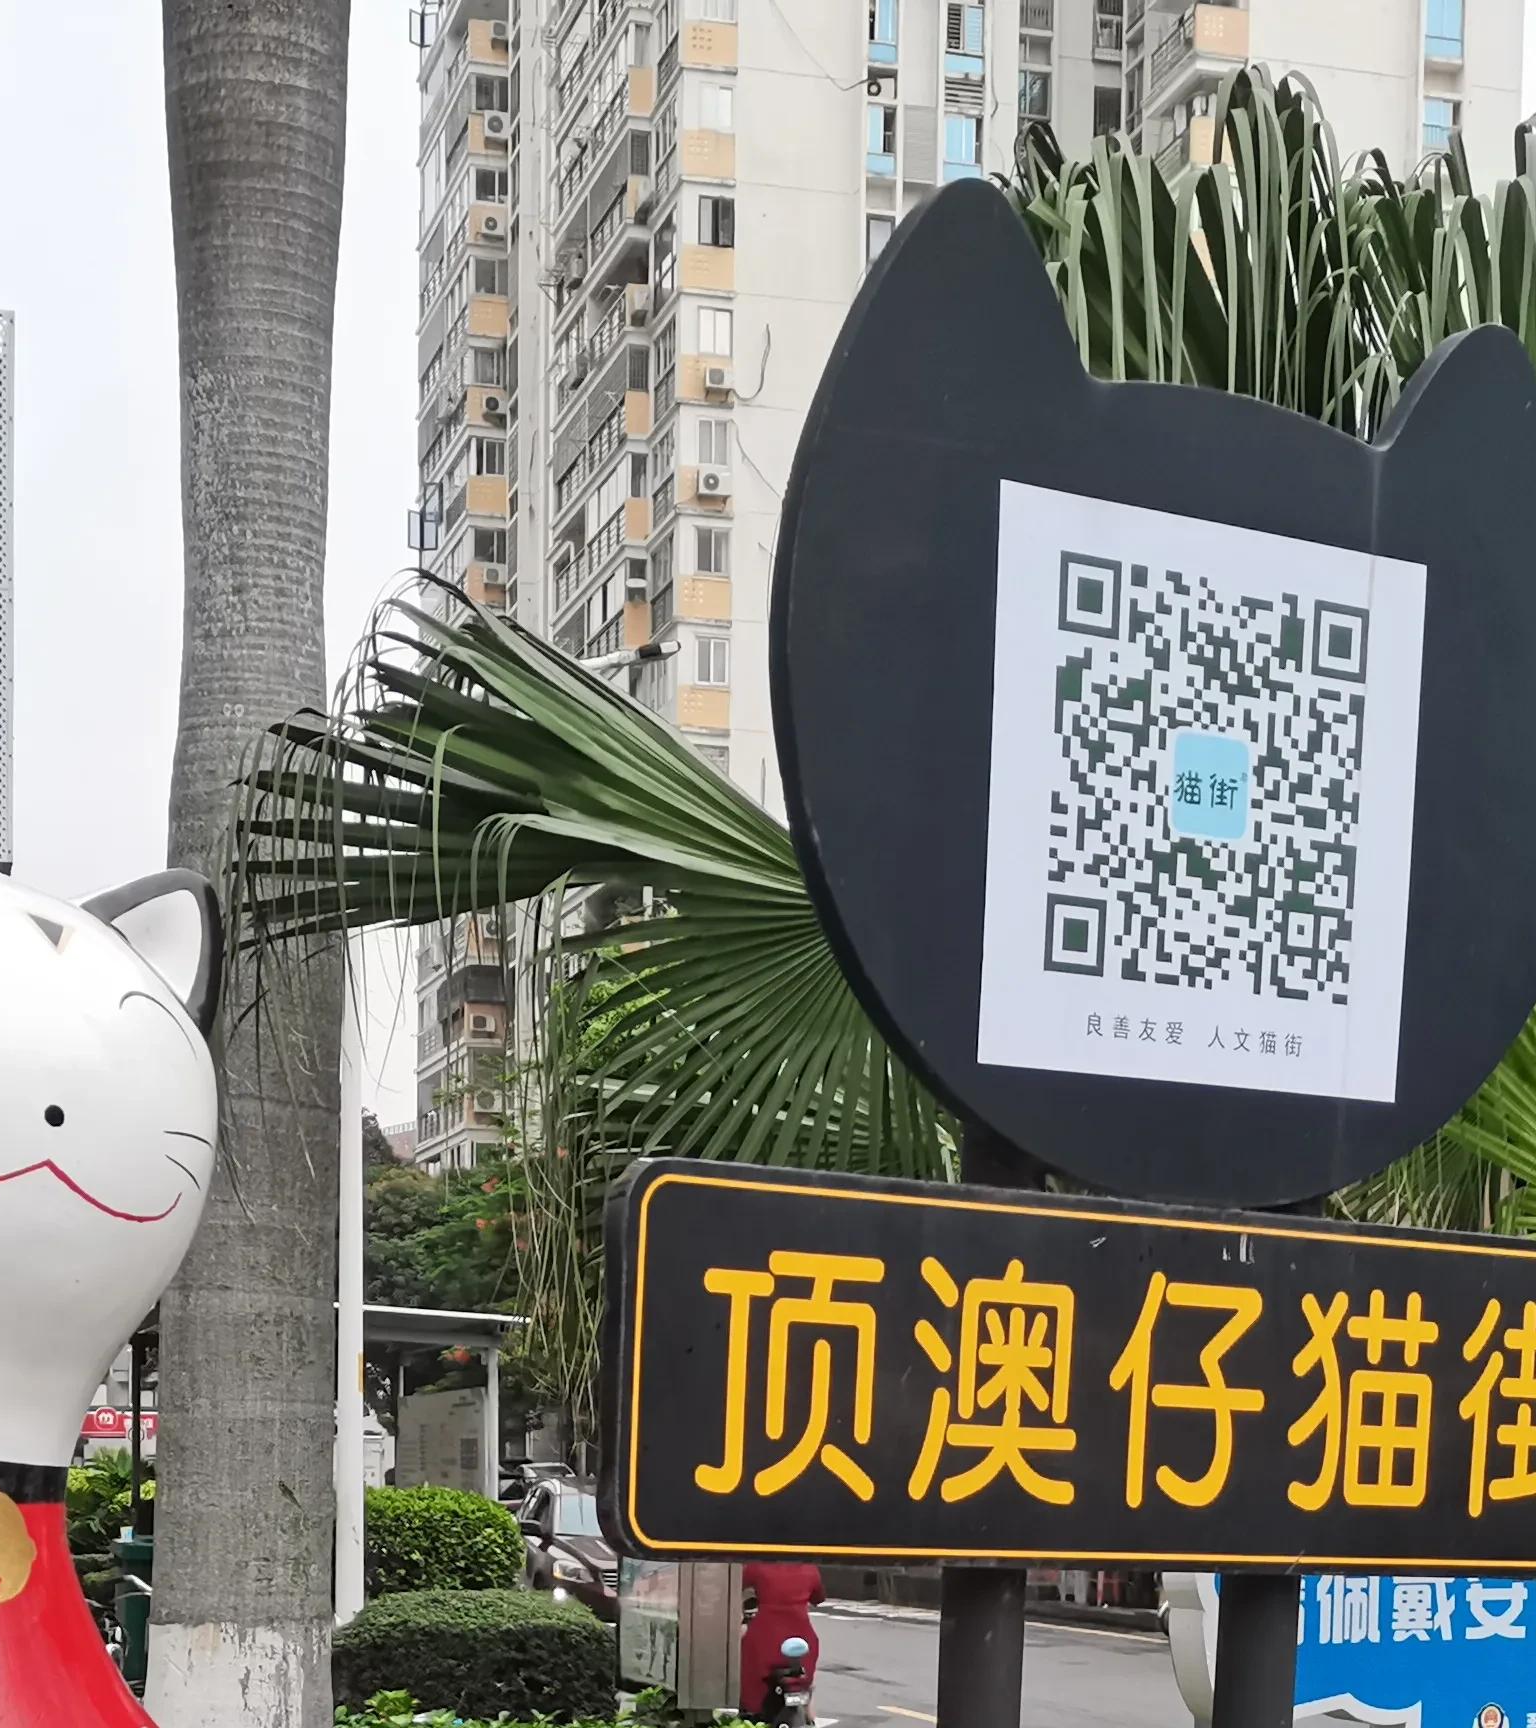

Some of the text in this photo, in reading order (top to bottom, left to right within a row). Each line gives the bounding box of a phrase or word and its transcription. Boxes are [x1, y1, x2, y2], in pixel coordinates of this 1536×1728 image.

[1173, 770, 1239, 811] 猫街
[1086, 1011, 1303, 1058] 良善友爱 人文猫街
